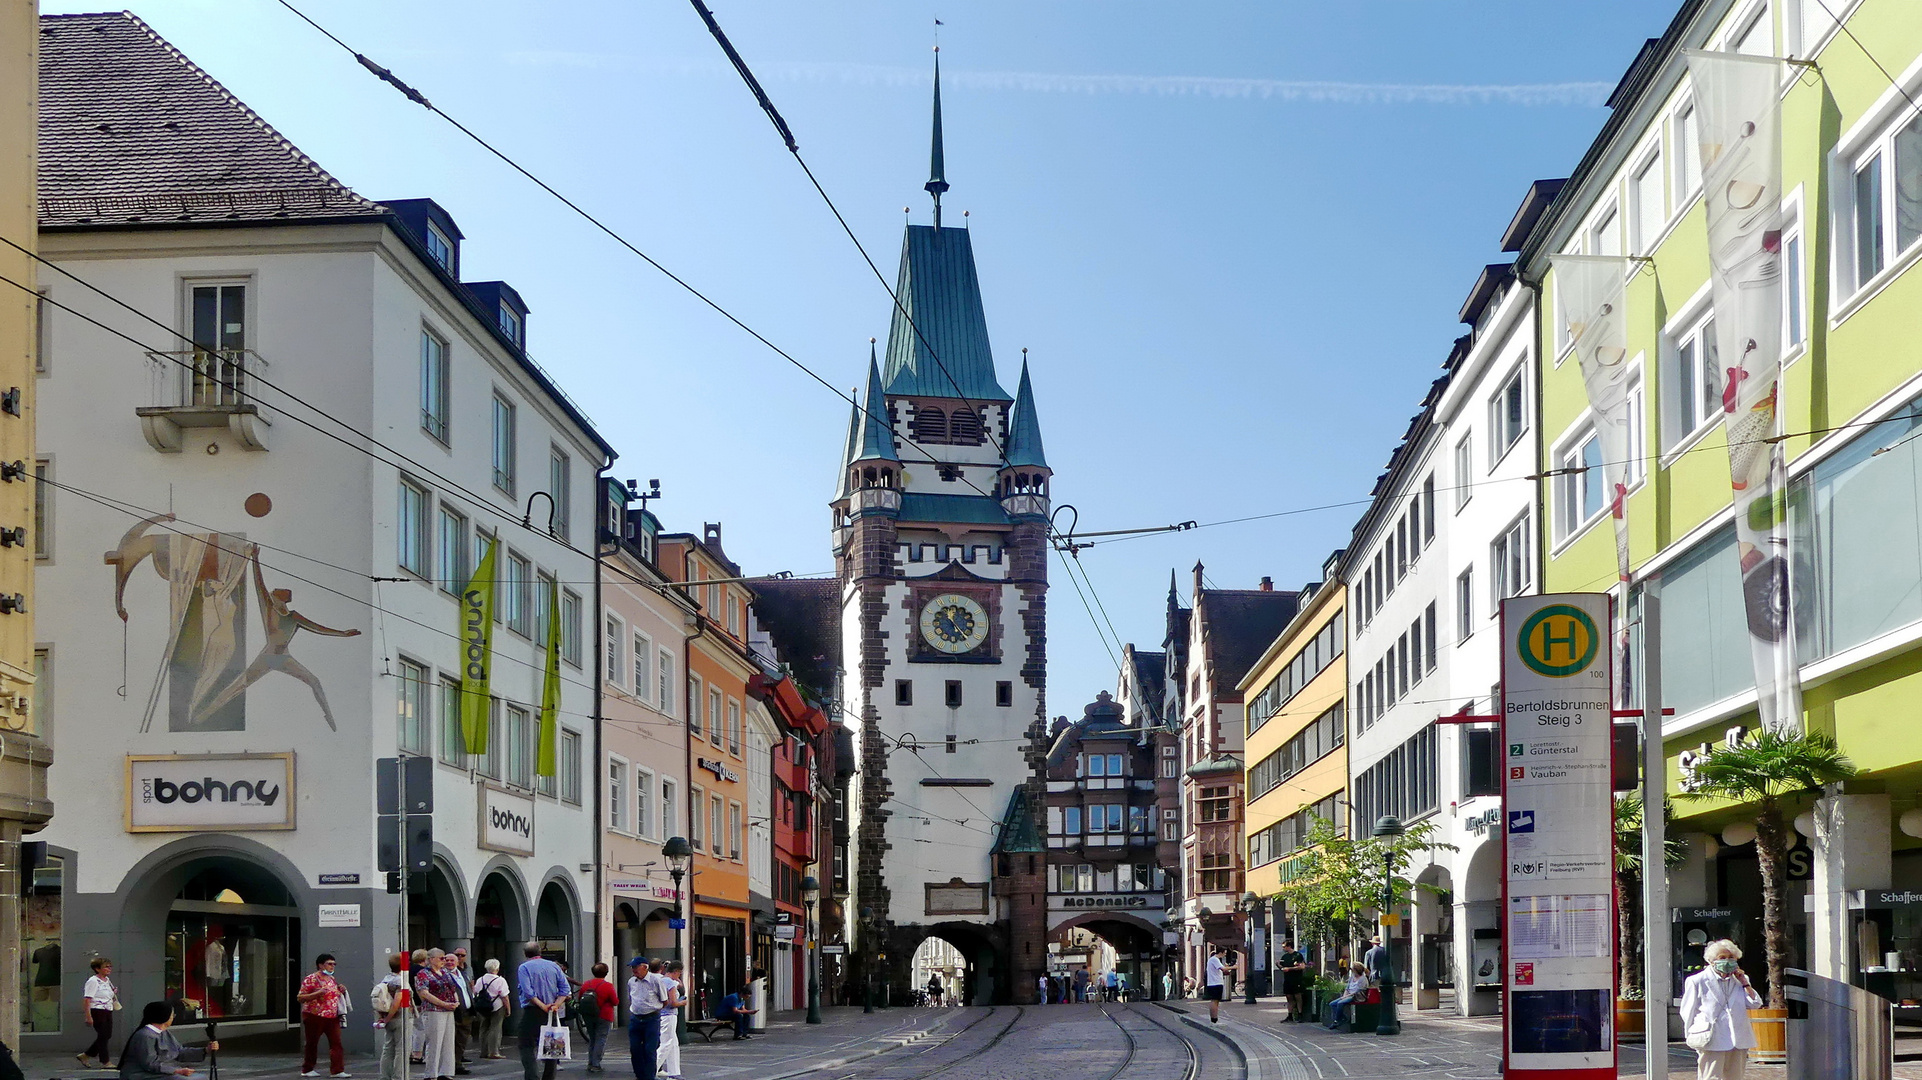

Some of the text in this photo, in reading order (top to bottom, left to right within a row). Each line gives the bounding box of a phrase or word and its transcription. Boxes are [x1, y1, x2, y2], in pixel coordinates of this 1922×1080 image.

[1543, 620, 1577, 661] H
[1589, 670, 1604, 679] 100
[1507, 700, 1609, 714] Bertoldsbrunnen
[1538, 713, 1583, 728] Steig 3
[1512, 745, 1520, 755] 2
[1530, 746, 1579, 756] Günterstal
[1513, 768, 1521, 778] 3
[1531, 770, 1567, 779] Vauban
[141, 778, 154, 804] sport
[154, 777, 279, 806] bohny
[492, 805, 531, 839] bohny
[1789, 851, 1808, 876] S
[1063, 896, 1147, 907] McDonald's
[1693, 908, 1732, 918] Schafferer
